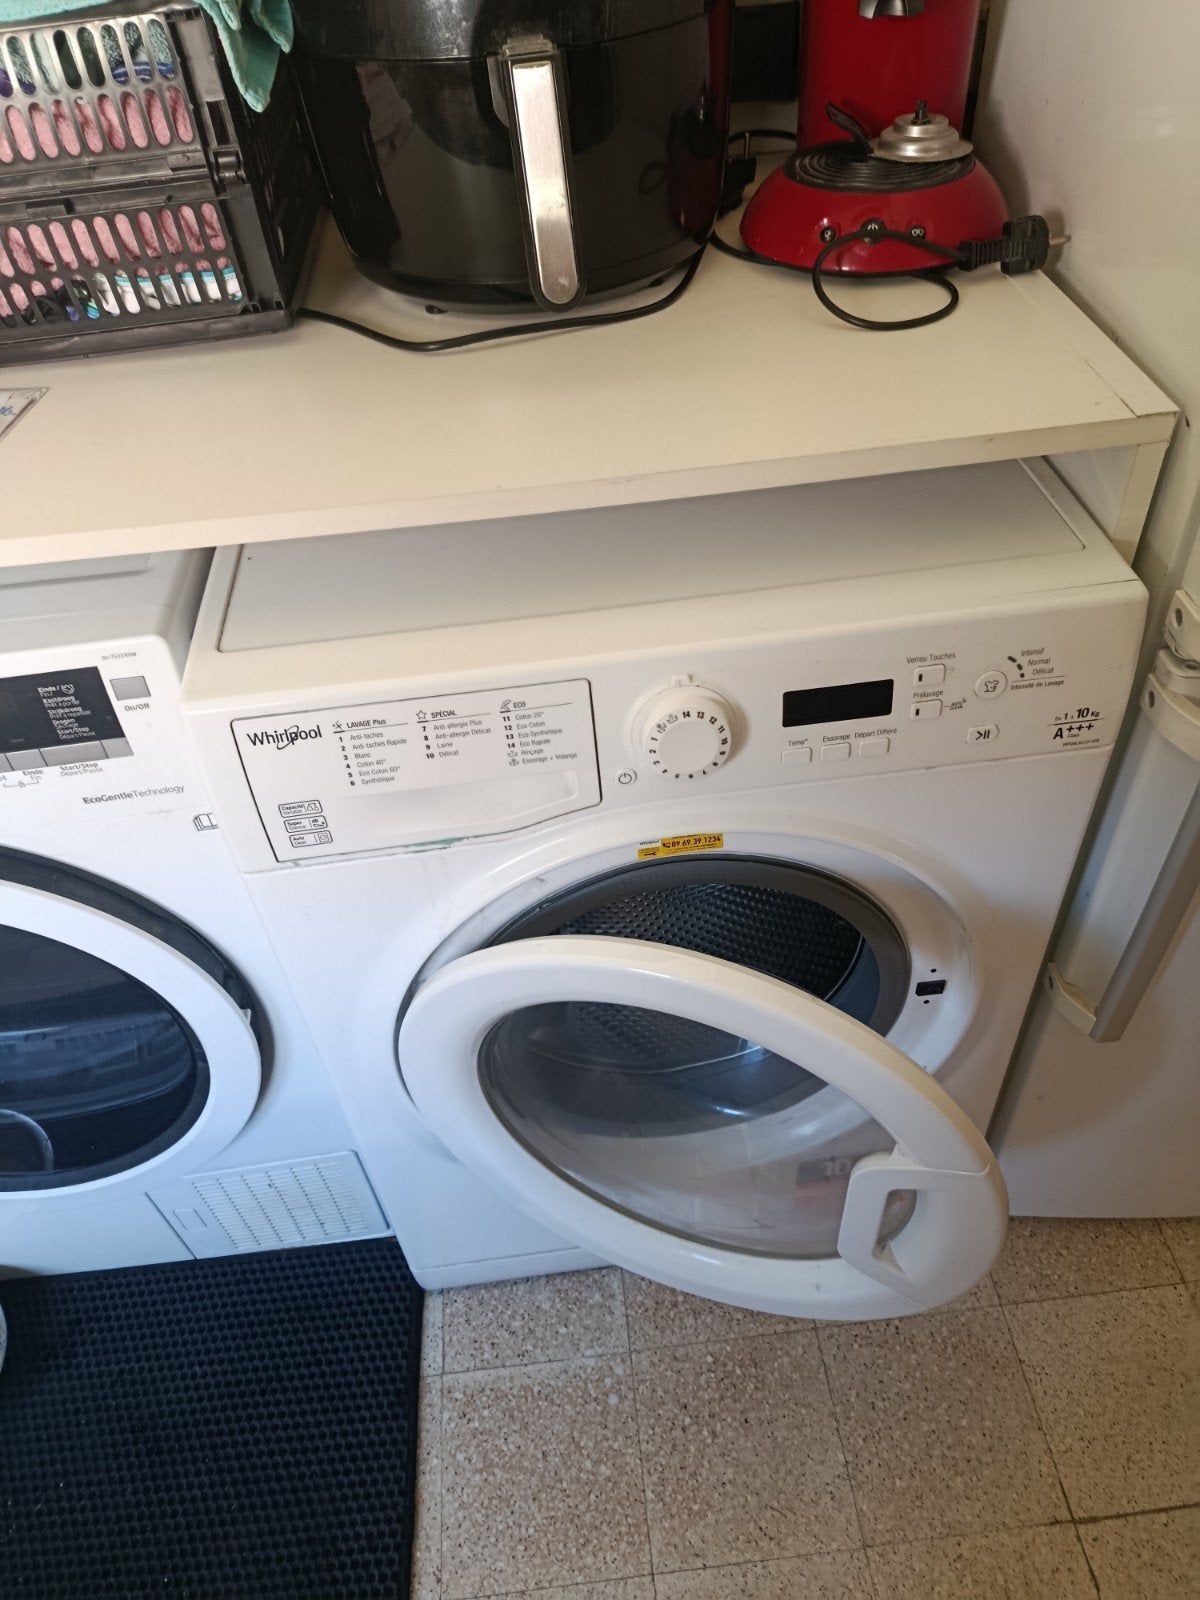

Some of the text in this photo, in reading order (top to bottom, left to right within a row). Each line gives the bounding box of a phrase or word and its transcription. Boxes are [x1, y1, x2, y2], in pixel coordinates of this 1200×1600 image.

[1028, 657, 1051, 666] Normal
[124, 702, 150, 711] On/Off
[513, 701, 526, 709] ECO
[696, 711, 705, 719] 13
[1076, 708, 1090, 718] 10
[346, 720, 371, 729] LAVAGE
[709, 716, 718, 725] 12
[246, 724, 322, 750] Whirlpool
[350, 732, 383, 741] Anti-taches
[822, 733, 851, 742] Essorage
[352, 741, 386, 750] Anti-taches
[386, 738, 407, 746] Rapide
[60, 762, 98, 771] Start/Stop
[82, 785, 185, 804] EcoGentleTechnology
